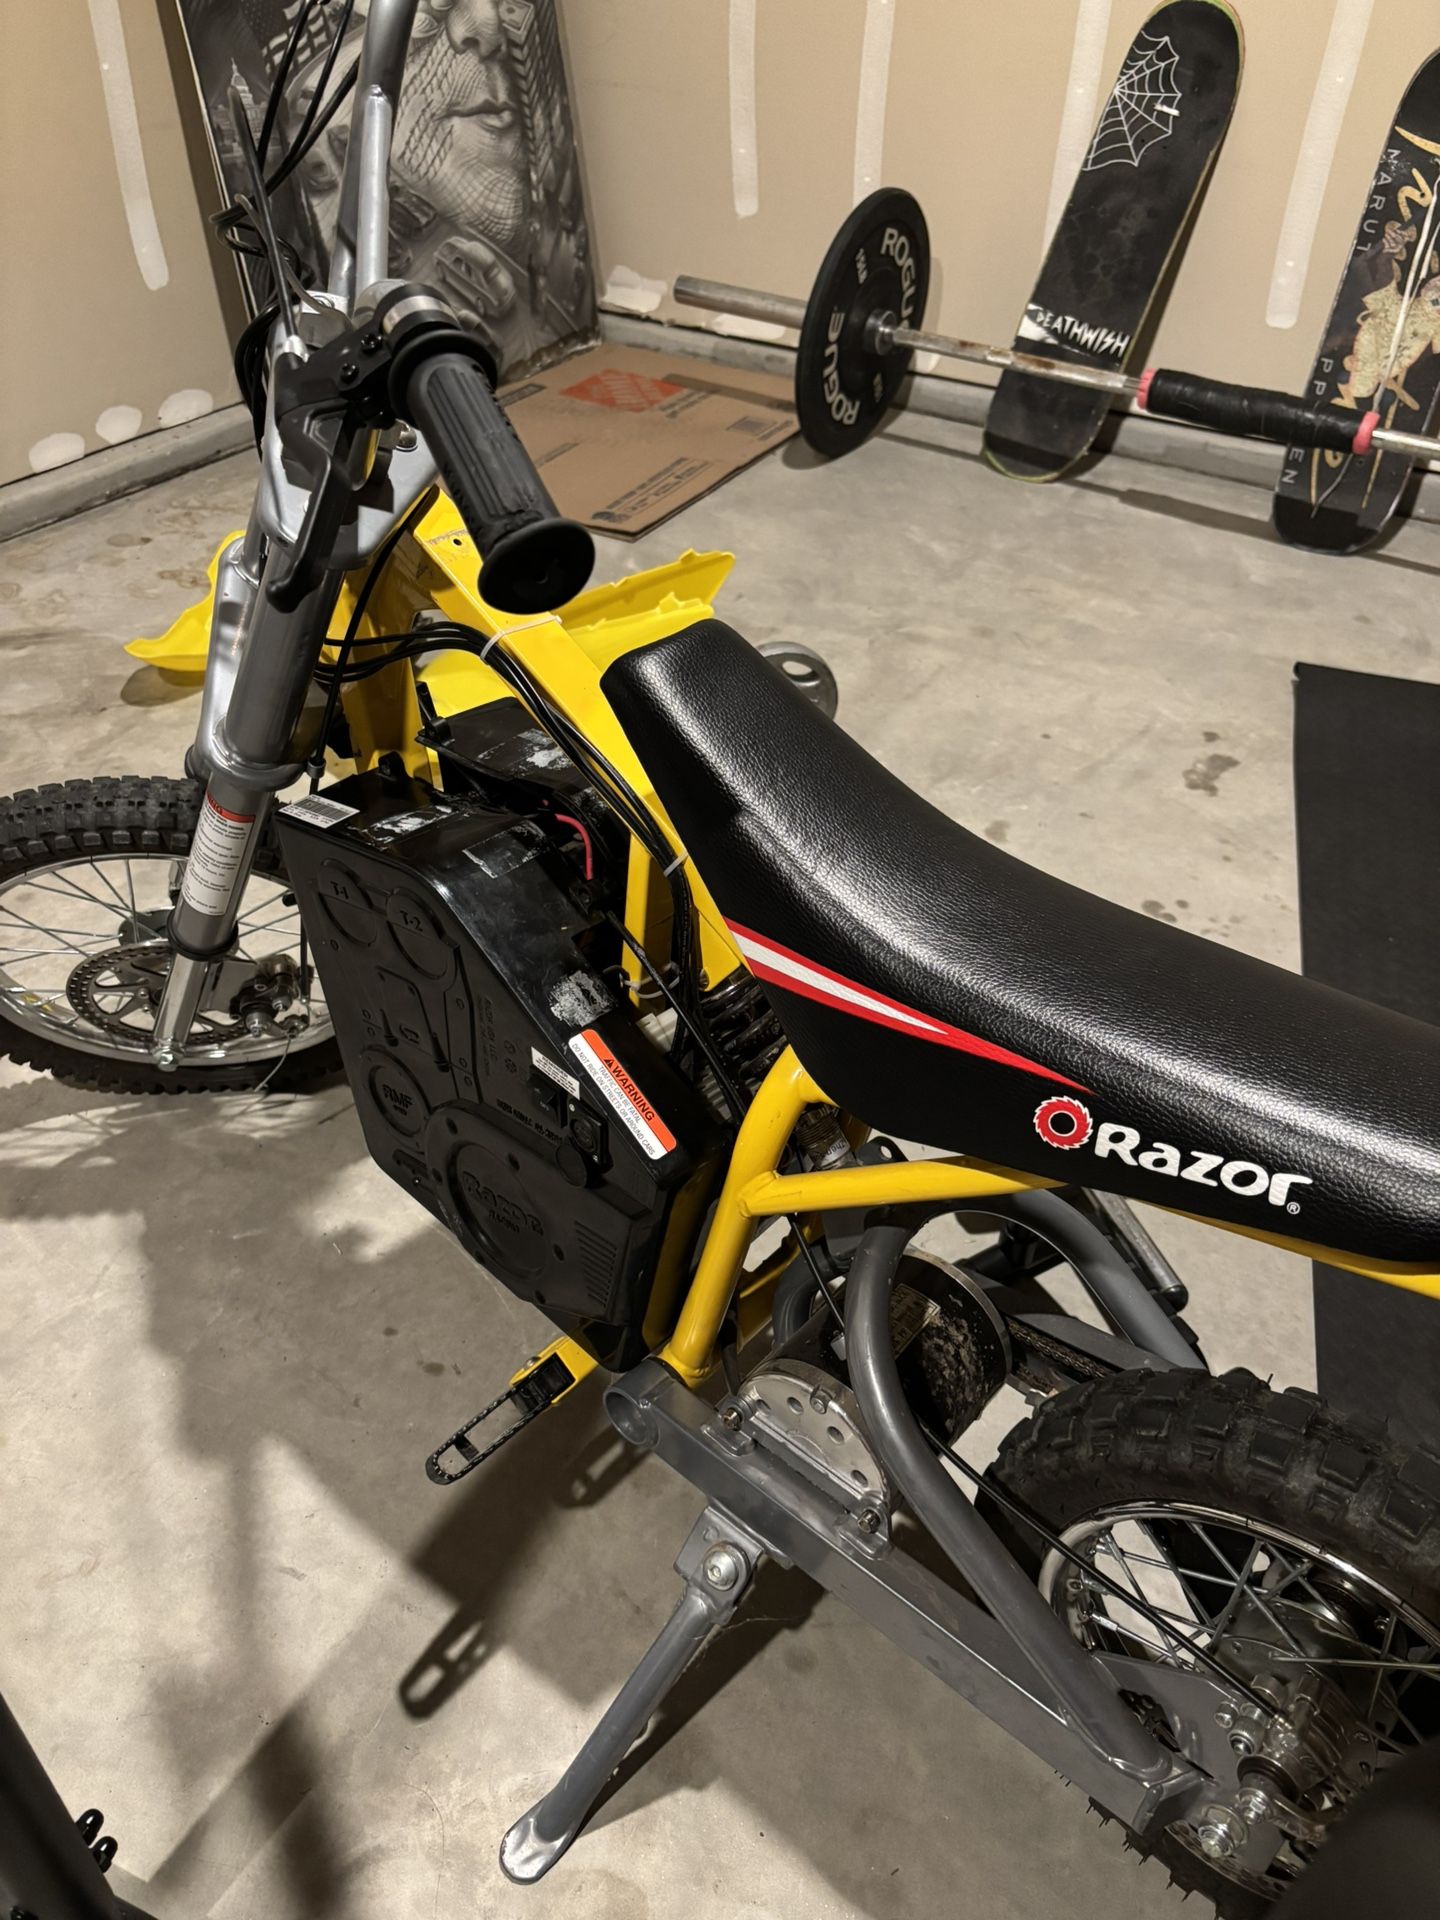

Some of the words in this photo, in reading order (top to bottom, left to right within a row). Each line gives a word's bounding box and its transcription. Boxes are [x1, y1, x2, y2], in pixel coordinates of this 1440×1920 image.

[880, 227, 918, 331] ROGU
[823, 312, 862, 425] ROGUE
[1036, 309, 1131, 358] DEATHWISH
[572, 1043, 582, 1053] DO
[579, 1051, 591, 1064] NOT
[587, 1063, 600, 1077] RIDE
[596, 1076, 605, 1086] ON
[602, 1085, 622, 1109] STREETS
[620, 1108, 629, 1118] OR
[626, 1117, 645, 1140] AROUND
[641, 1139, 656, 1155] CARS
[599, 1066, 617, 1088] TRAFFIC
[614, 1088, 626, 1100] CAN
[628, 1107, 642, 1124] FATAL
[612, 1065, 655, 1121] WARNING
